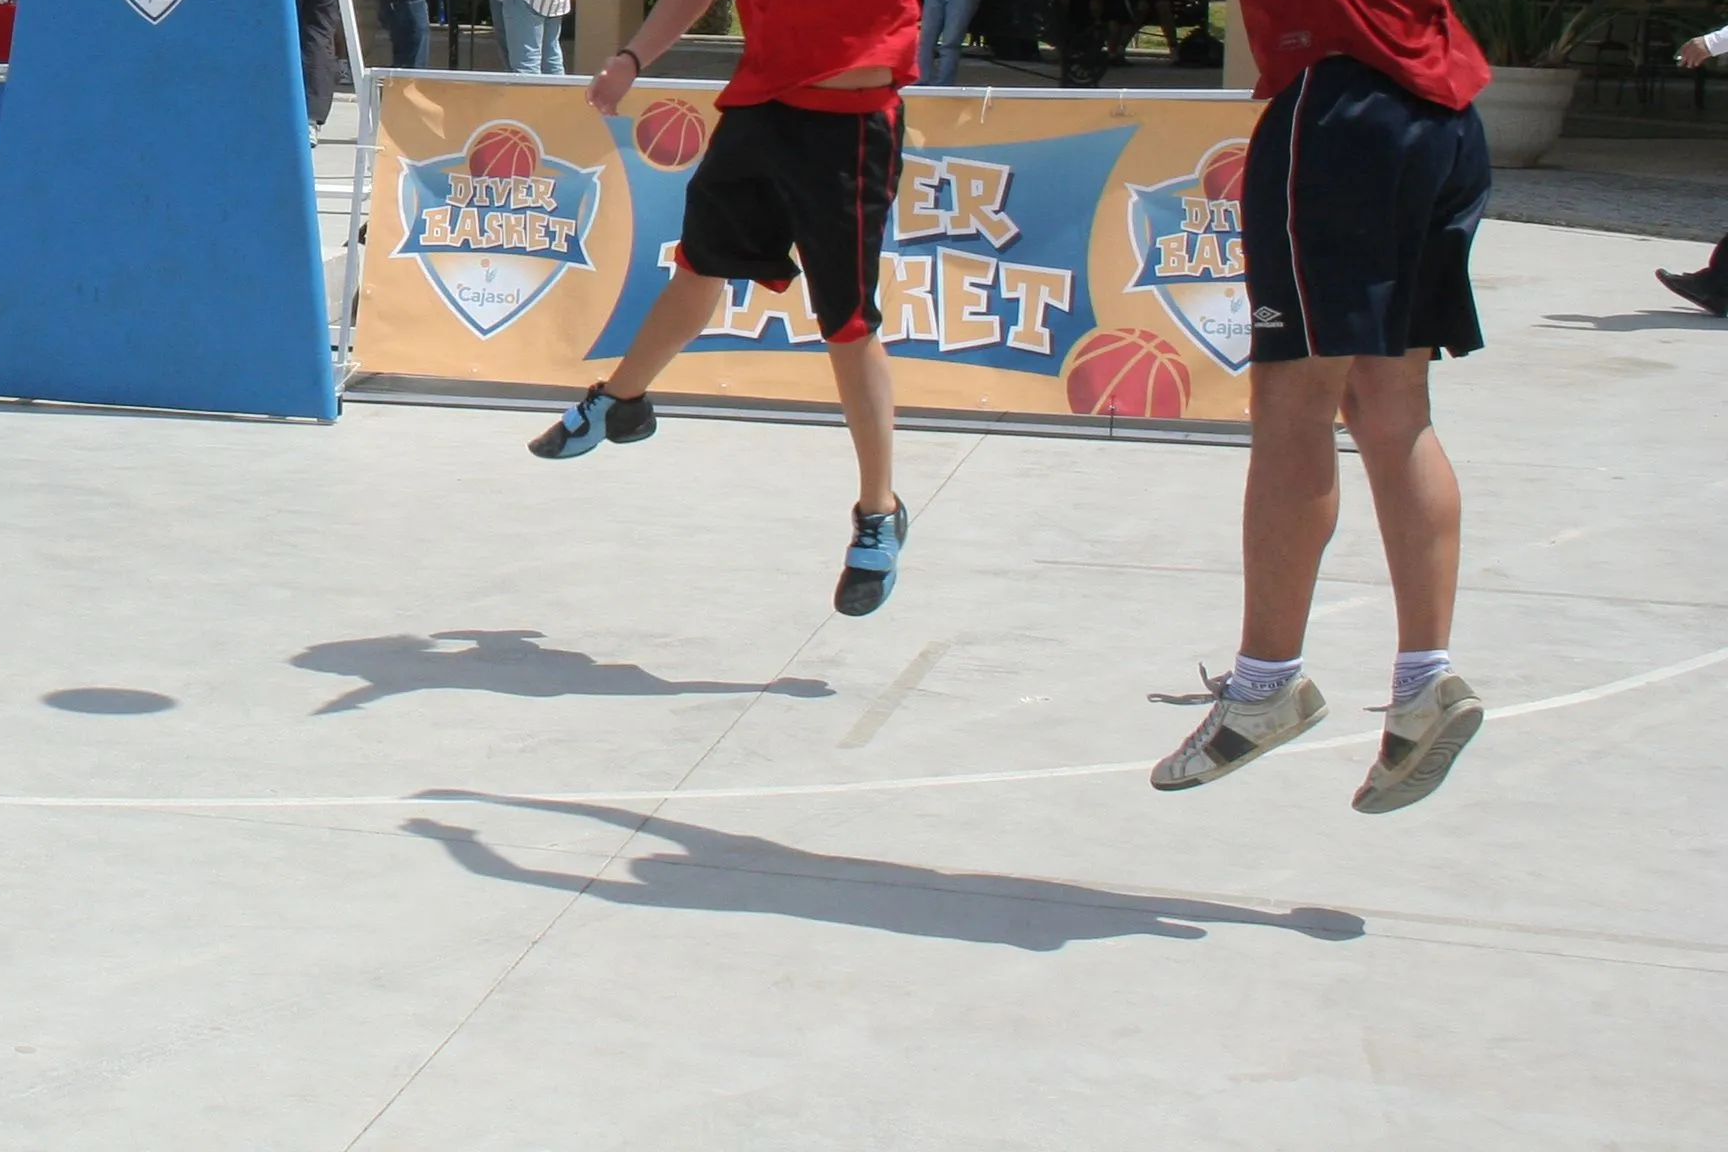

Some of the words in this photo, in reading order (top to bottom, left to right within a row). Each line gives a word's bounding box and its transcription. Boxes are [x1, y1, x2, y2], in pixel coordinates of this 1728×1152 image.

[446, 173, 558, 212] DIVER
[420, 205, 577, 253] BASKET
[456, 286, 521, 308] Cajasol
